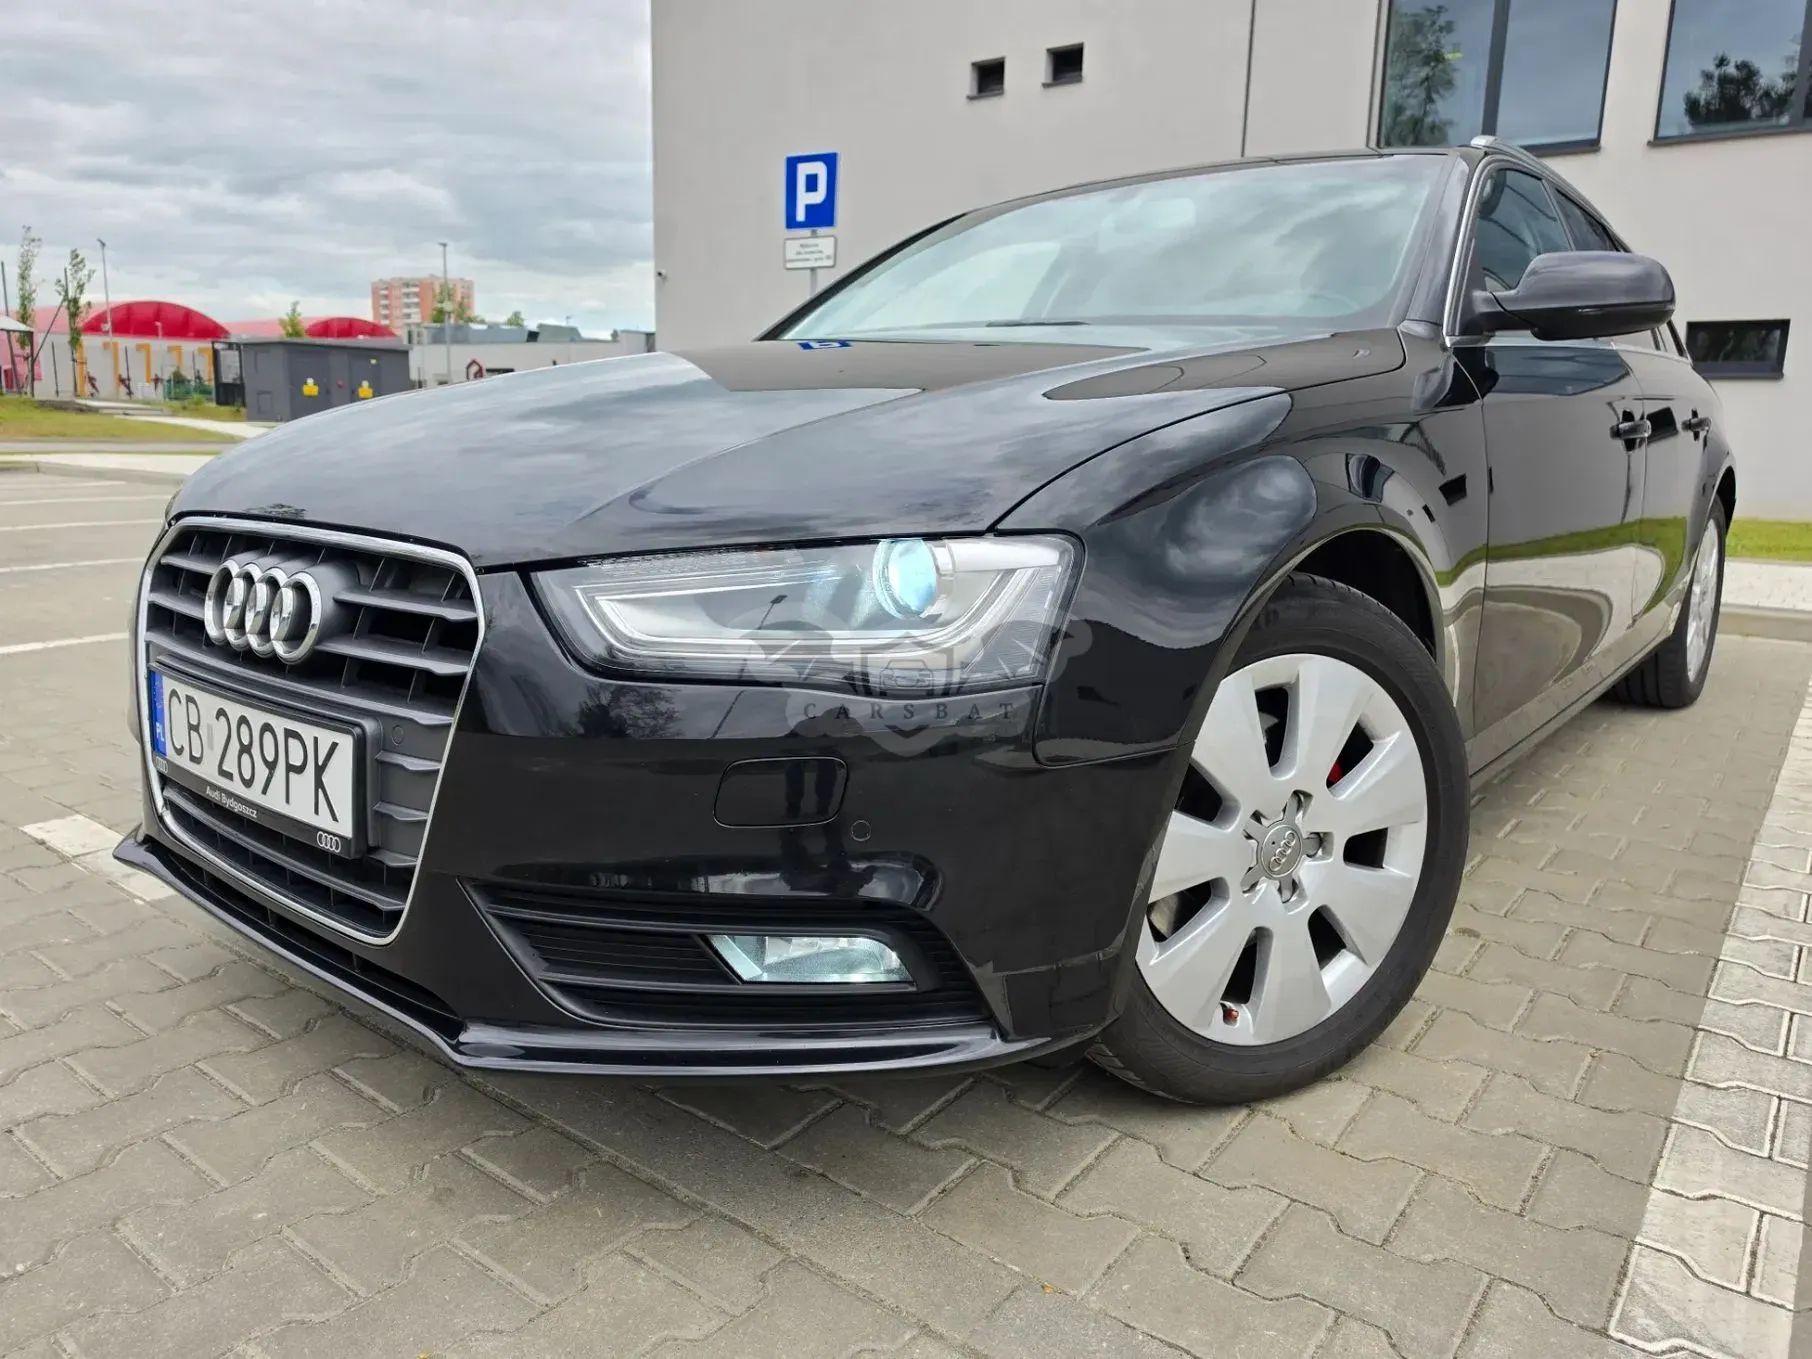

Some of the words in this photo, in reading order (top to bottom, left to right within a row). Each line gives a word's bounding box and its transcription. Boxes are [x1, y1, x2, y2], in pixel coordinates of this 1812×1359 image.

[796, 160, 828, 222] P
[155, 721, 165, 742] PL
[168, 688, 204, 765] CB
[215, 707, 340, 823] 289PK
[206, 786, 221, 801] Audi
[221, 793, 257, 818] Bydgoszcz
